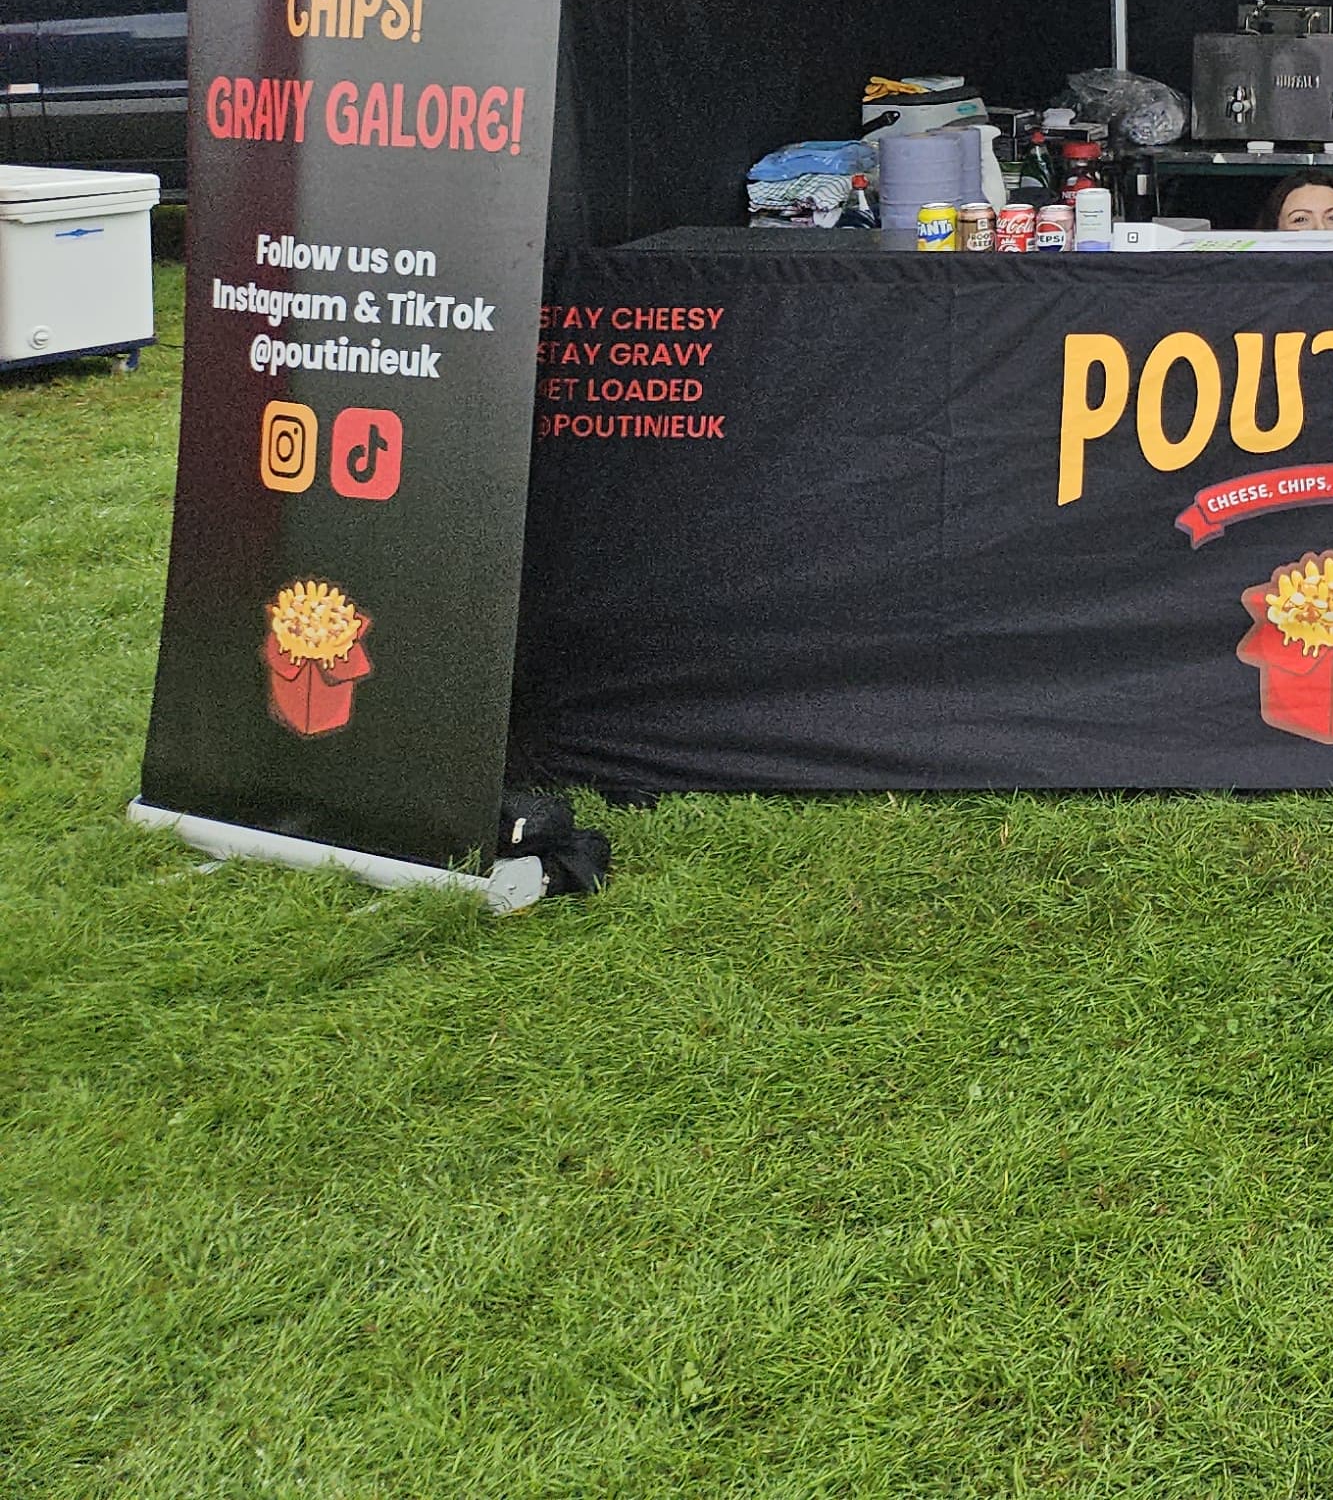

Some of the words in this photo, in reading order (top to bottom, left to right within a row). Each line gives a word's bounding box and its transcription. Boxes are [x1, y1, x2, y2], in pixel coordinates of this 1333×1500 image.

[206, 75, 315, 143] GRAVY
[325, 81, 526, 157] GALORE!
[256, 233, 341, 271] Follow
[347, 246, 389, 274] us
[394, 249, 437, 277] on
[212, 277, 348, 327] Instagram
[354, 290, 382, 324] &
[387, 290, 497, 332] TikTok
[539, 305, 604, 330] STAY
[611, 306, 725, 331] CHEESY
[250, 333, 443, 378] @poutinieuk
[537, 341, 602, 366] STAY
[609, 342, 713, 366] GRAVY
[539, 378, 580, 401] ET
[587, 378, 703, 402] LOADED
[1207, 482, 1273, 513] CHEESE,
[1278, 476, 1332, 494] CHIPS,
